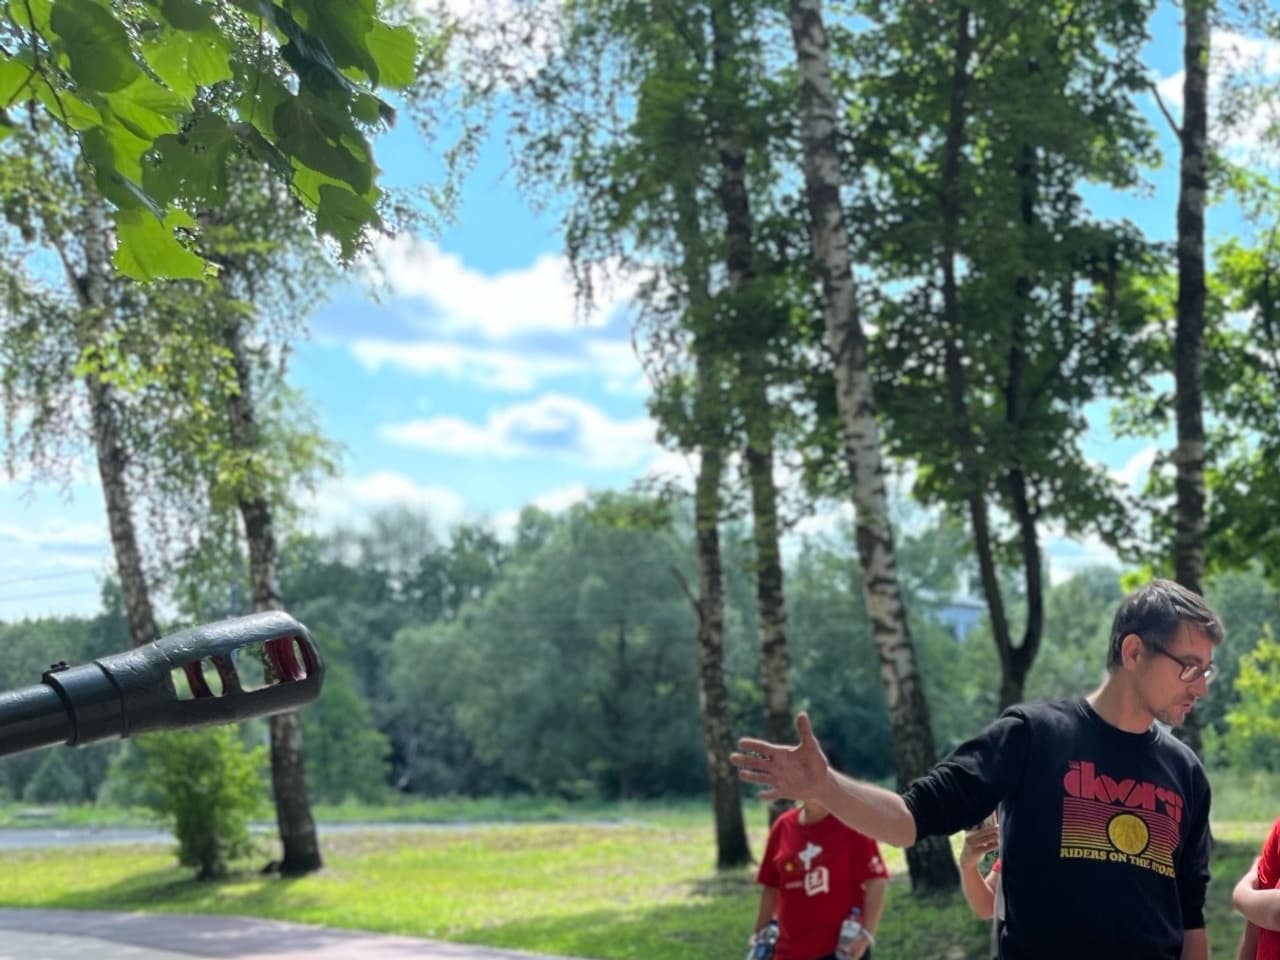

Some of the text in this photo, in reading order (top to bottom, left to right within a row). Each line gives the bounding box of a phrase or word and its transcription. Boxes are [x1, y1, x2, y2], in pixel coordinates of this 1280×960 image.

[1060, 847, 1107, 861] RIDERS
[1109, 852, 1127, 863] ON
[1128, 855, 1151, 869] THE
